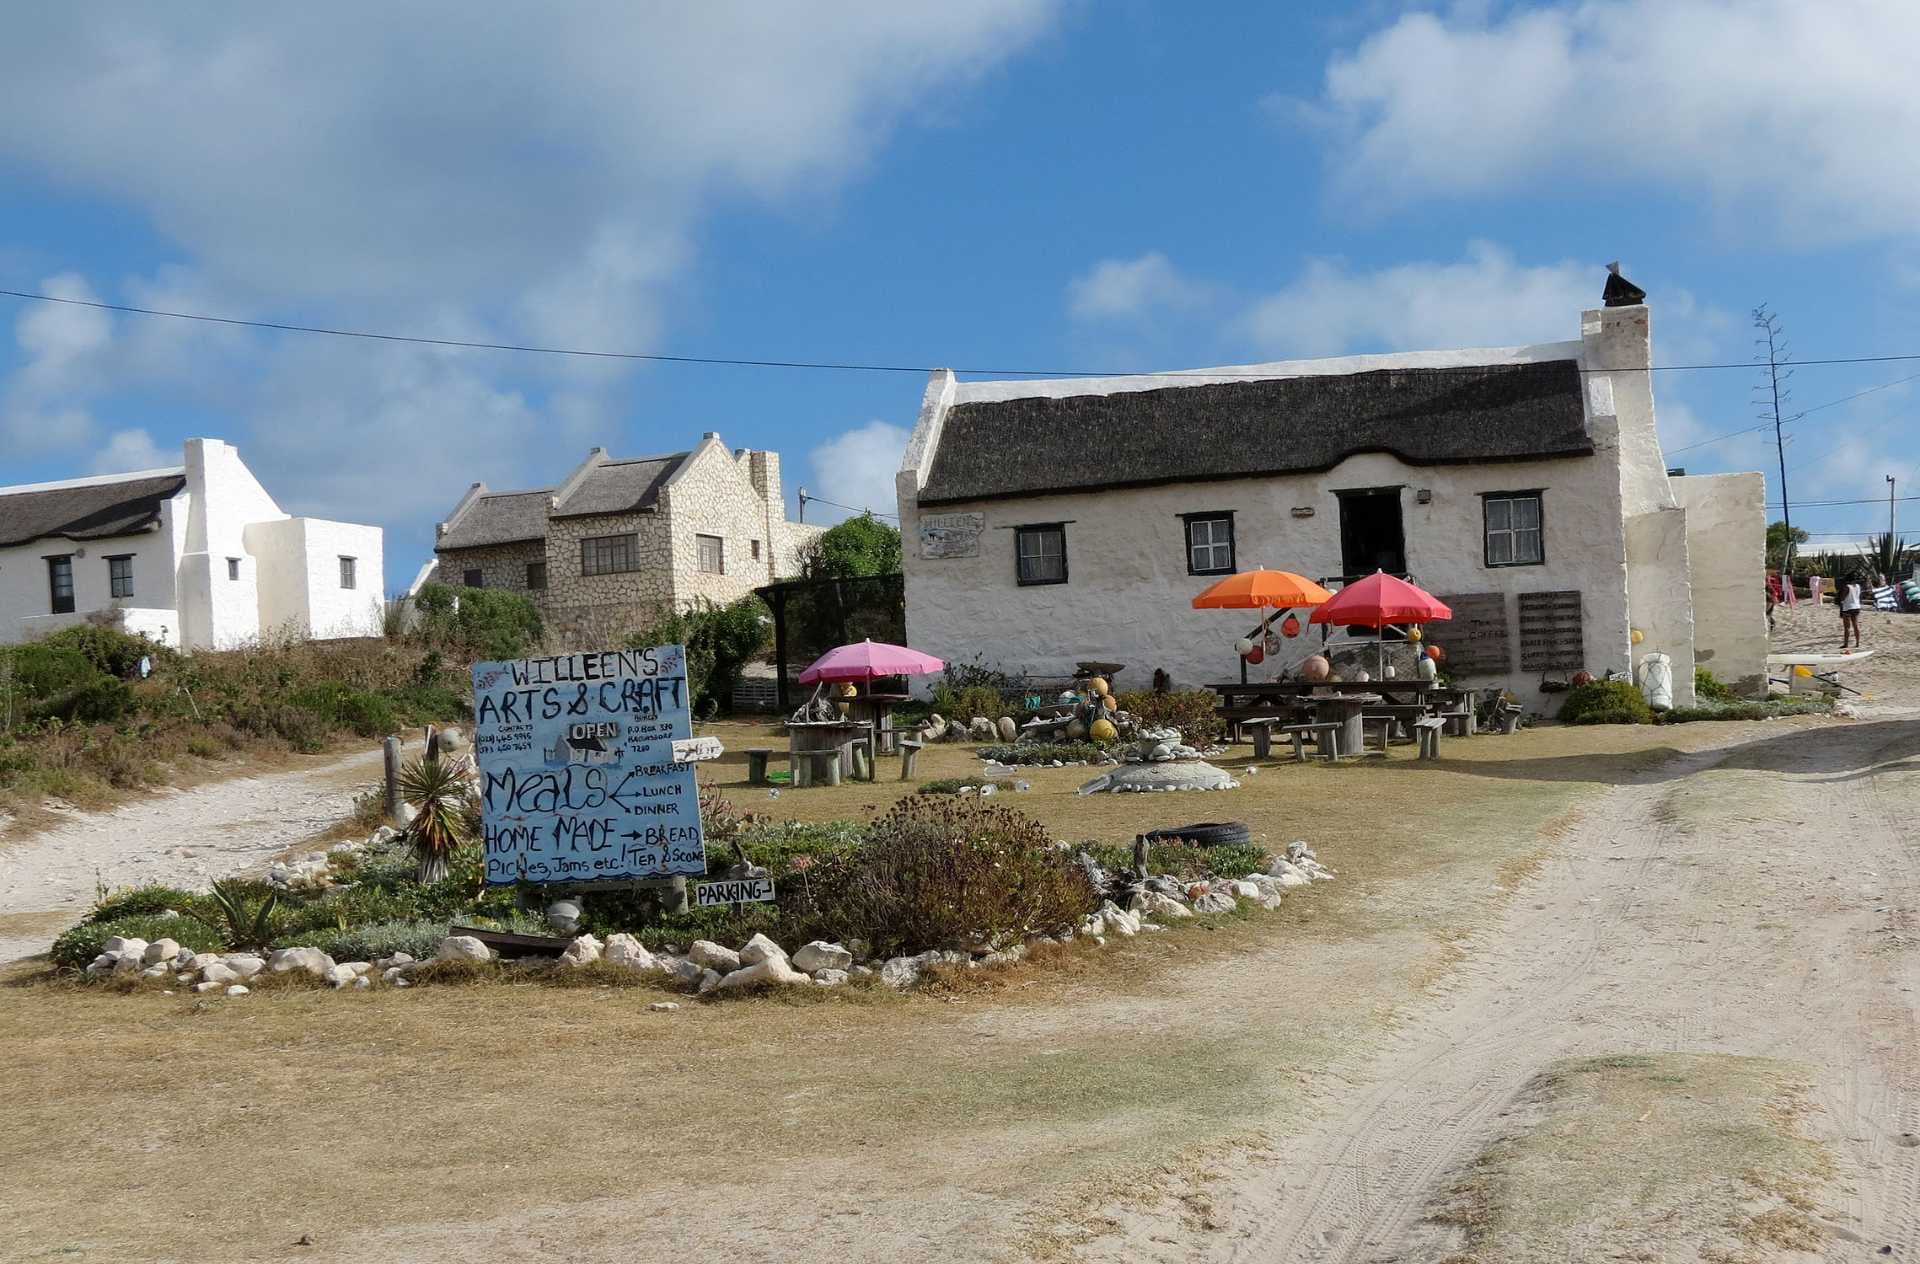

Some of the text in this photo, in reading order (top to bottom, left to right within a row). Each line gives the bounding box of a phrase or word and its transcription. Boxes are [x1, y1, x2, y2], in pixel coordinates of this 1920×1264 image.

[511, 648, 659, 686] WILLEEN'S
[480, 677, 686, 724] ARTS & CRAFT
[572, 722, 617, 740] OPEN
[635, 762, 691, 777] BREAKFAST
[643, 785, 682, 798] LUNCH
[634, 804, 680, 815] DINNER
[485, 823, 543, 854] HOME
[552, 816, 618, 853] MADE
[552, 857, 590, 872] Jams
[698, 881, 761, 905] PARKING
